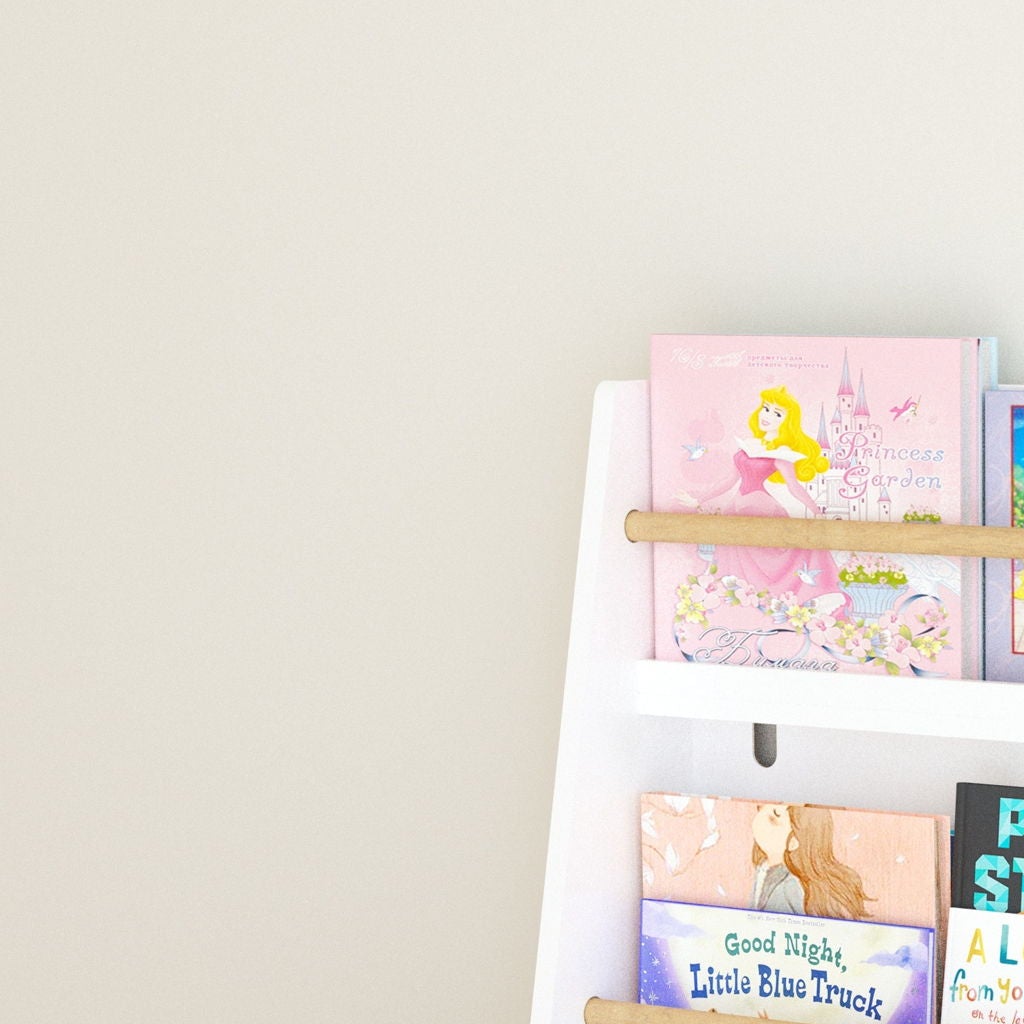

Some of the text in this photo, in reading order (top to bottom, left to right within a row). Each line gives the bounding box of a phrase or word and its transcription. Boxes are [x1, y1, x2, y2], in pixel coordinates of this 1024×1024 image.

[836, 431, 945, 462] Princess
[839, 465, 942, 499] Garden
[724, 930, 847, 973] Good Night,
[966, 927, 986, 964] A
[689, 963, 883, 1021] Little Blue Truck
[949, 968, 994, 1003] from
[971, 1009, 985, 1020] on
[988, 1010, 1006, 1024] the
